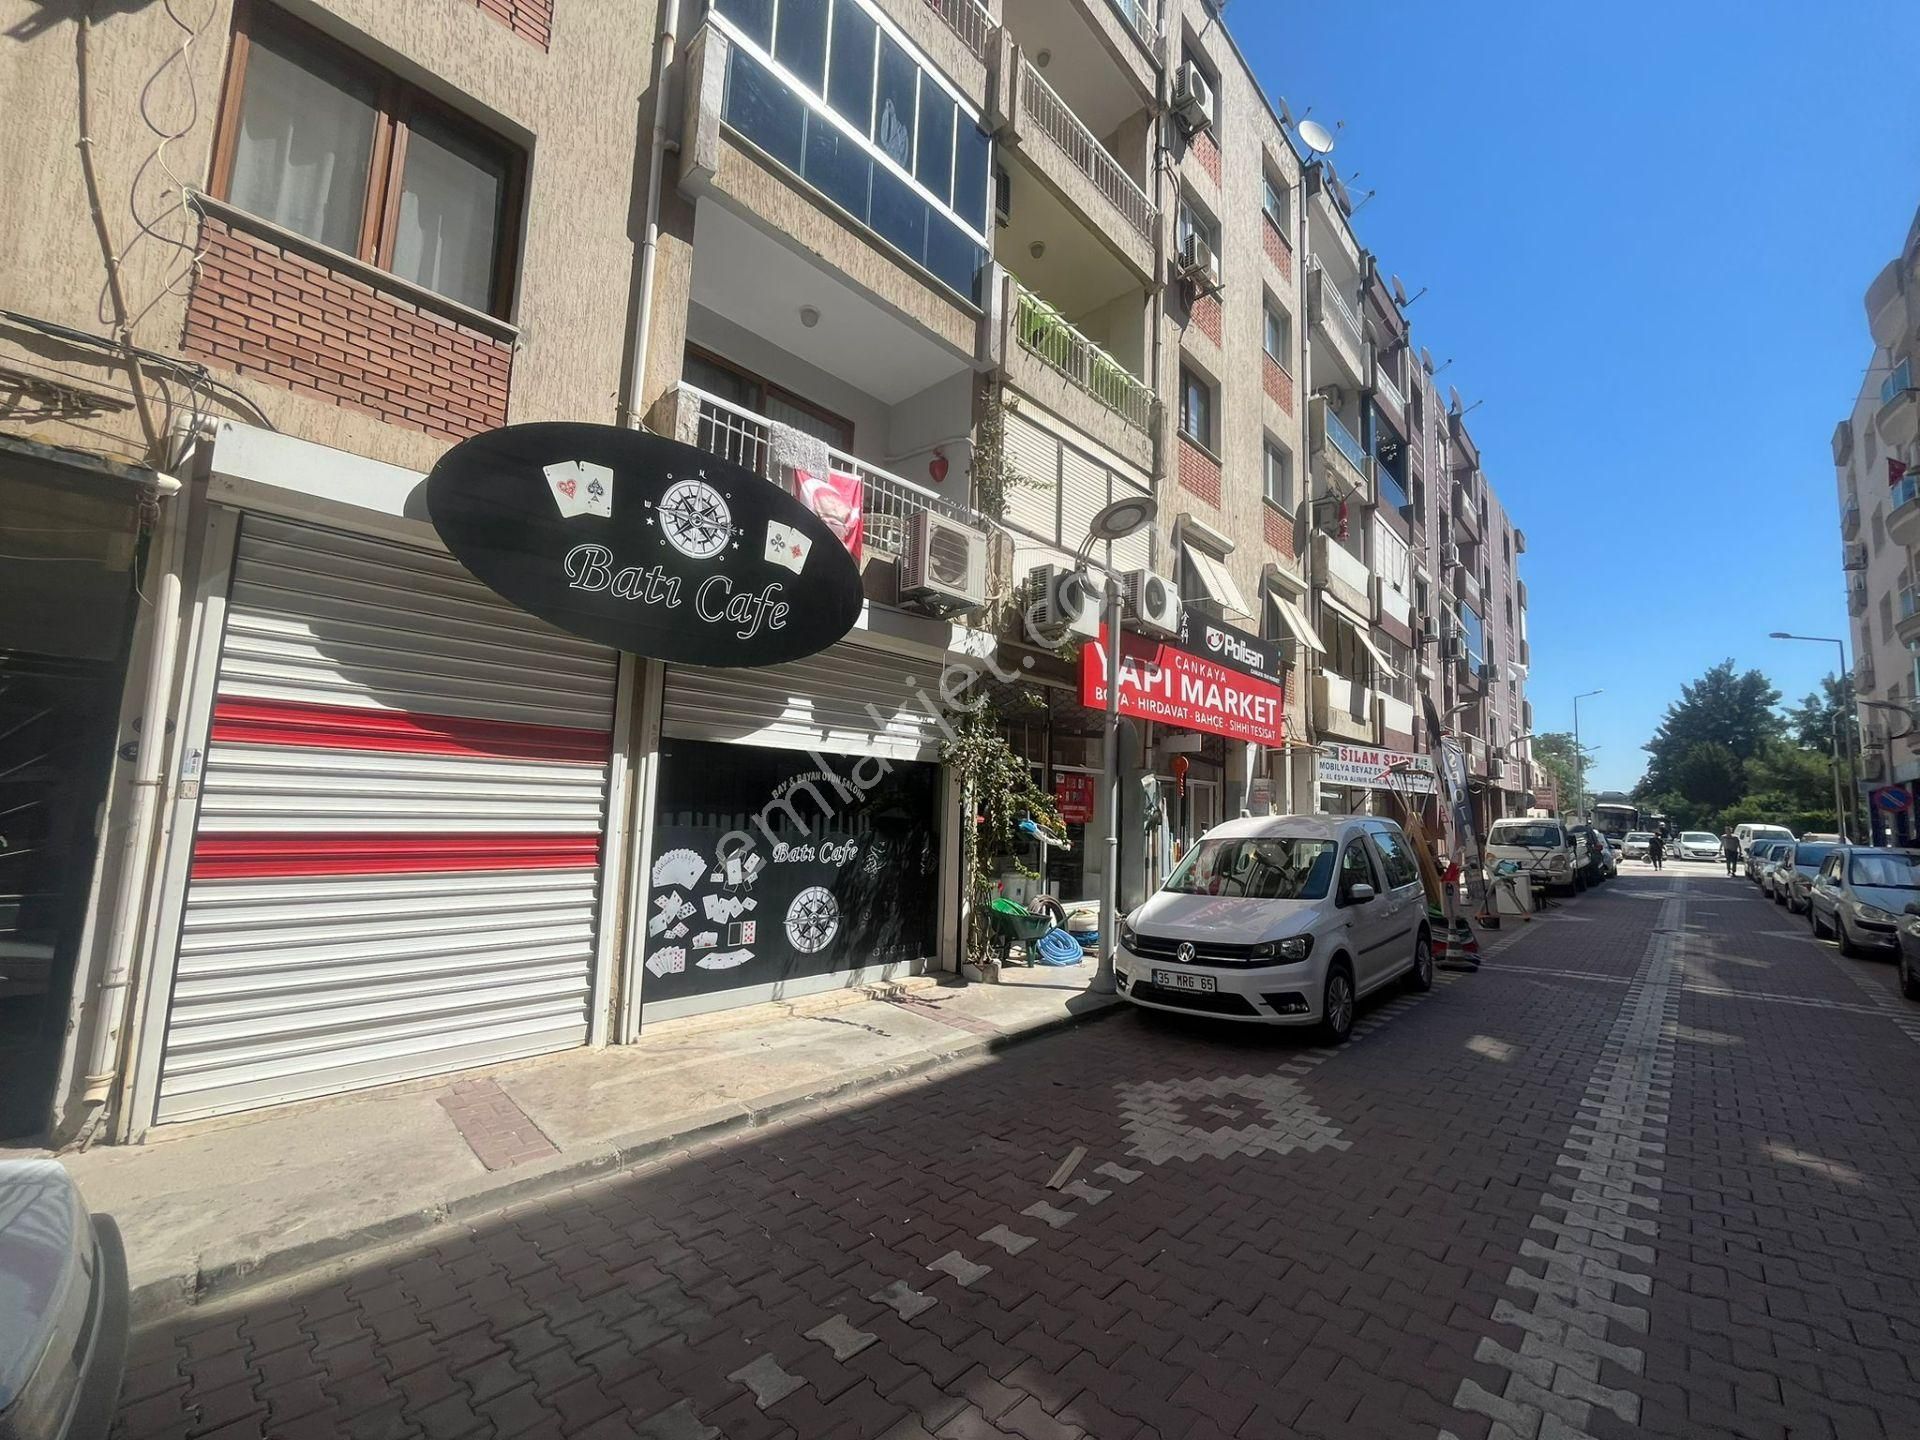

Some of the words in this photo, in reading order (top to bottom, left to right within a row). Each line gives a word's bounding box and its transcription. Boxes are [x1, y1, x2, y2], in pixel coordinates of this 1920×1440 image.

[563, 543, 682, 608] Batı
[695, 574, 790, 640] Cafe
[1175, 654, 1227, 683] CANKAYA
[1224, 634, 1264, 669] Polisan
[1093, 641, 1171, 698] YAPI
[1181, 674, 1277, 726] MARKET
[1095, 687, 1129, 706] BA
[1138, 697, 1188, 720] HIRDAVAT
[1194, 711, 1223, 730] BAHÇE
[819, 838, 859, 867] Cafe
[1158, 972, 1170, 984] 35
[1176, 974, 1194, 988] MRG
